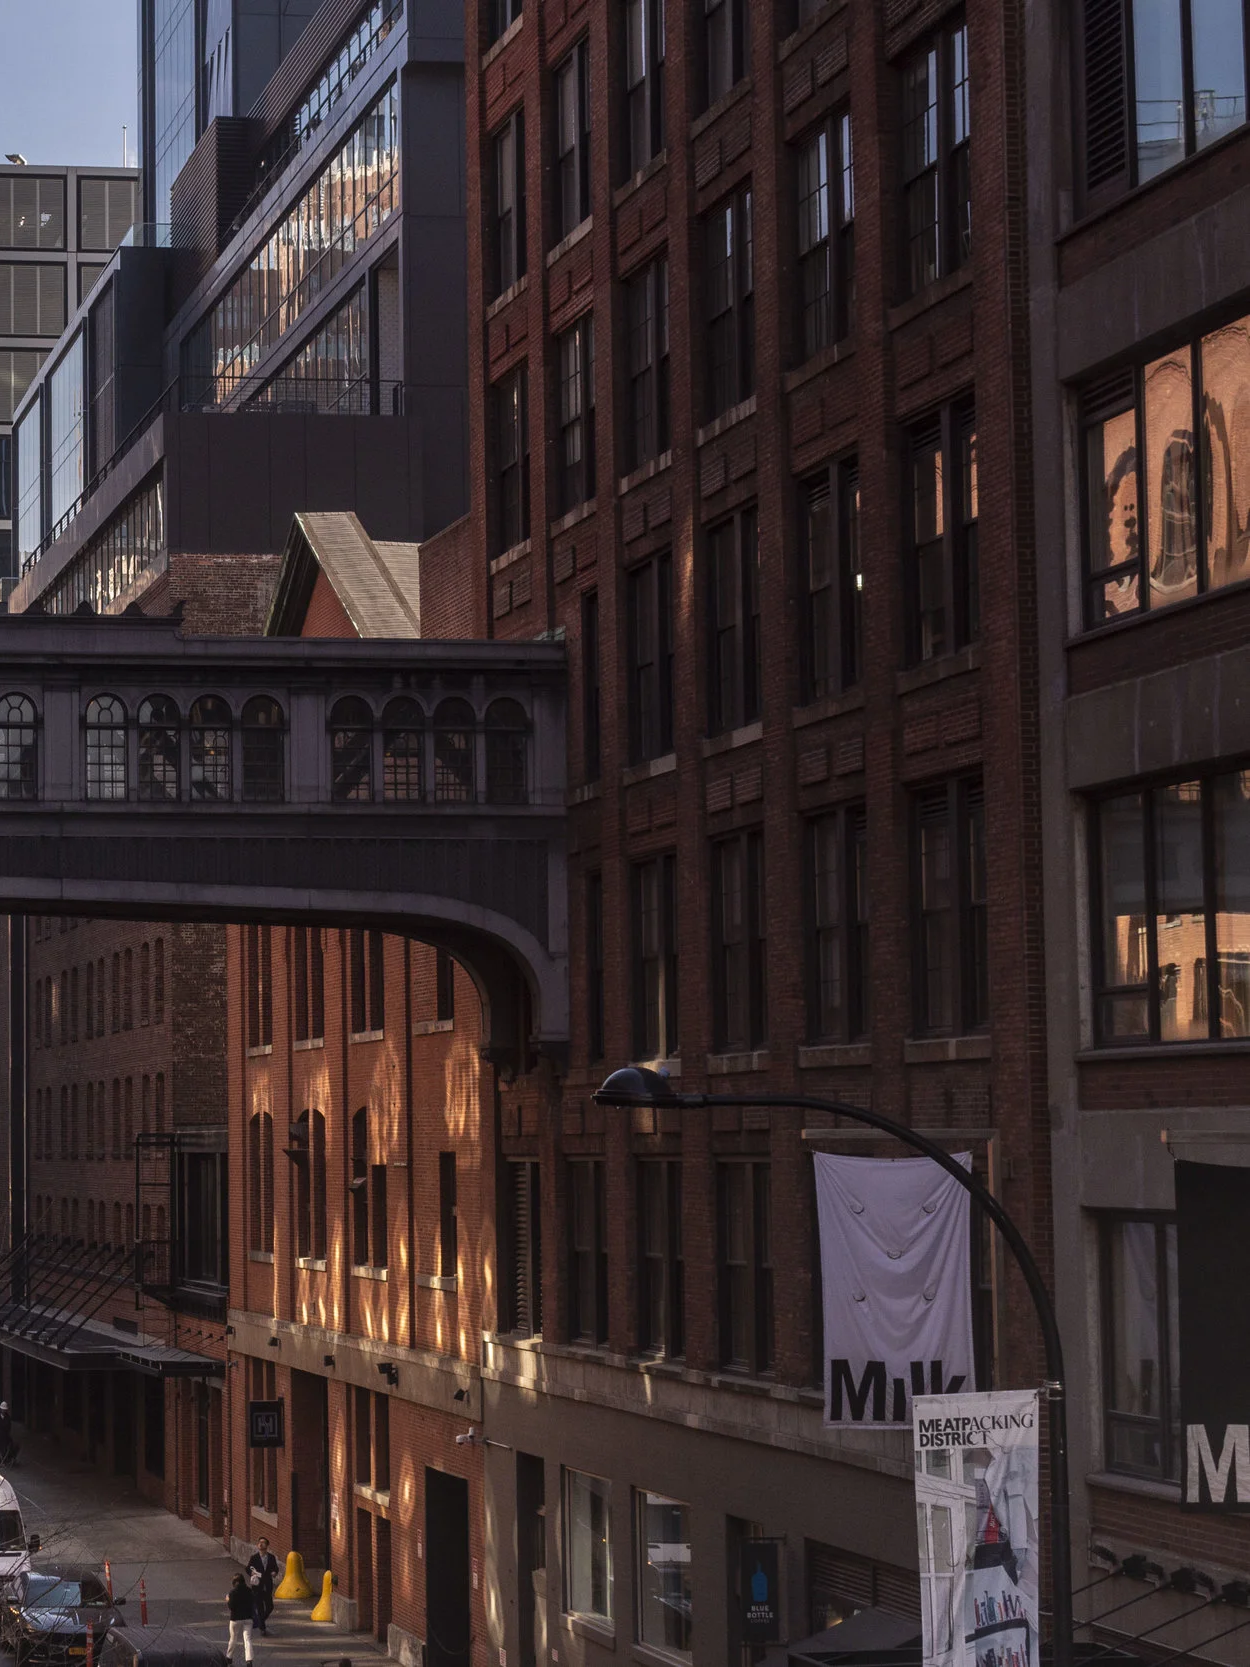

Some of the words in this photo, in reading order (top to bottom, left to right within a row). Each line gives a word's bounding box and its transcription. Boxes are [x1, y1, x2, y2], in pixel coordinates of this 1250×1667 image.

[919, 1413, 1034, 1433] MEATPACKING
[919, 1431, 991, 1447] DISTRICT
[746, 1611, 774, 1619] BOTTLE
